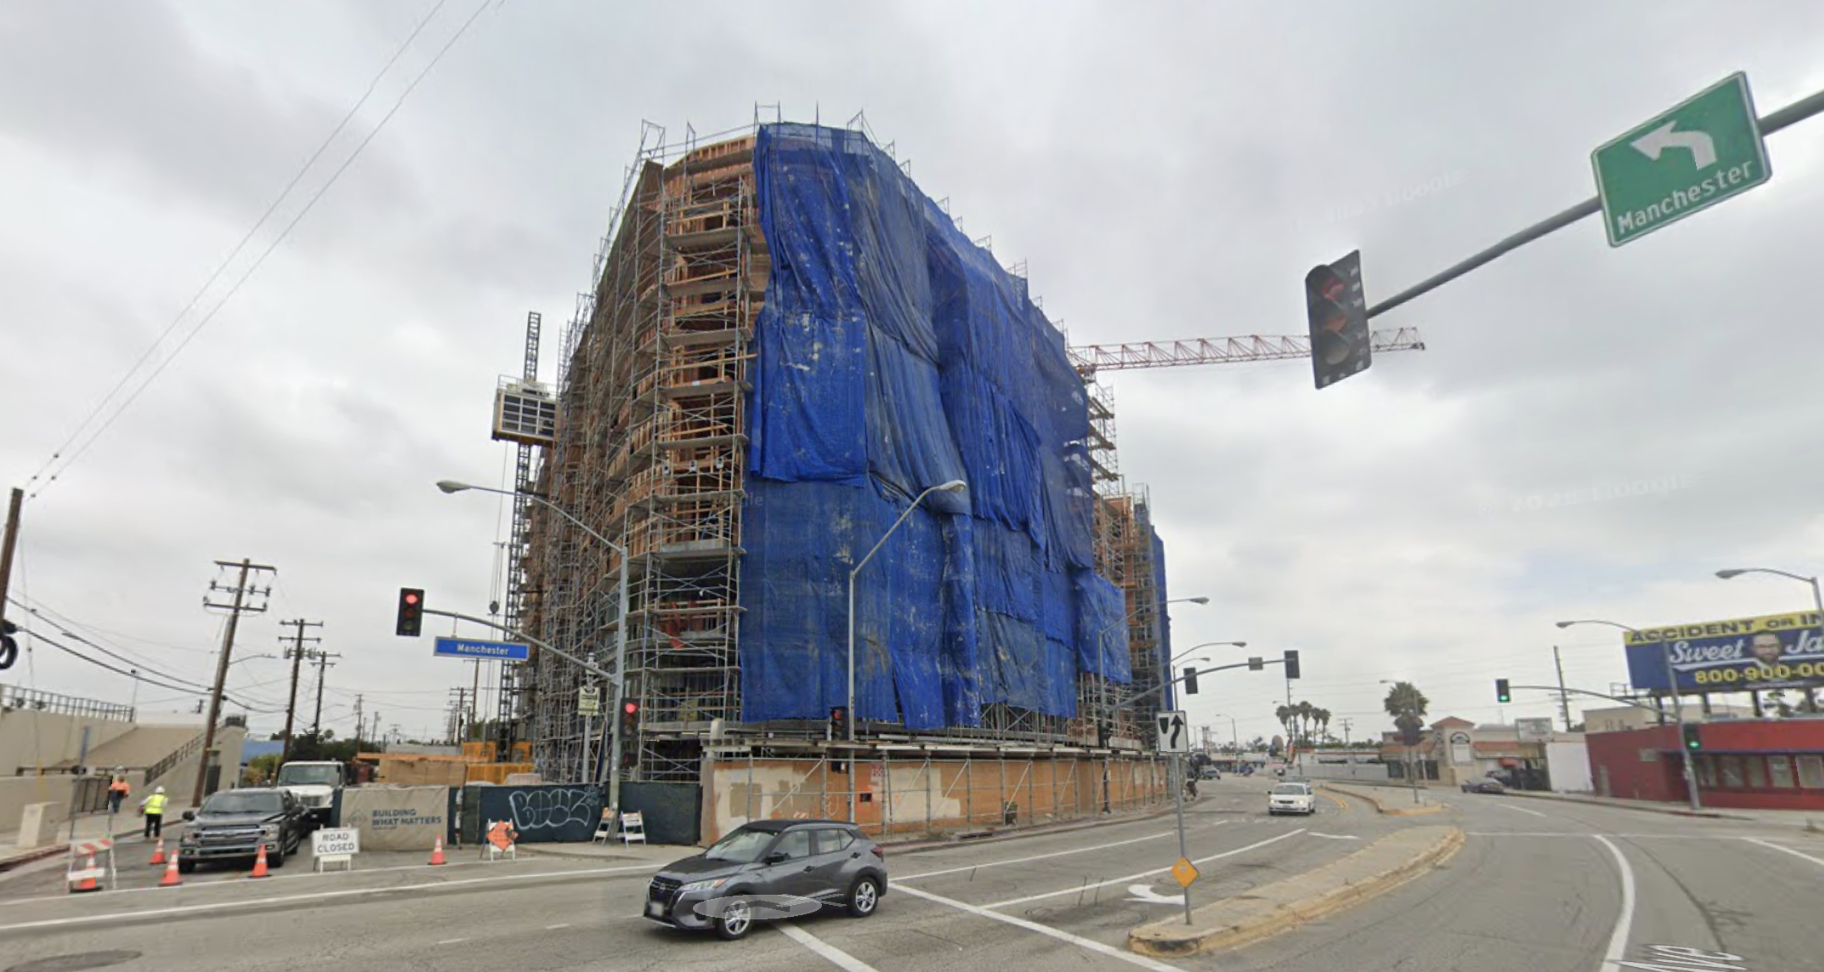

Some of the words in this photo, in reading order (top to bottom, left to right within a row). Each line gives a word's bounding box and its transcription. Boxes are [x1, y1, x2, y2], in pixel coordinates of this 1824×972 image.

[1616, 160, 1753, 235] Manchester
[1631, 620, 1755, 642] ACCIDENT
[1766, 618, 1794, 629] OR
[456, 643, 510, 655] Manchester
[1669, 638, 1745, 663] Sweet
[372, 808, 417, 817] BUILDING
[372, 817, 399, 826] WHAT
[401, 815, 443, 825] MATTERS
[322, 832, 349, 842] ROAD
[317, 842, 355, 854] CLOSED
